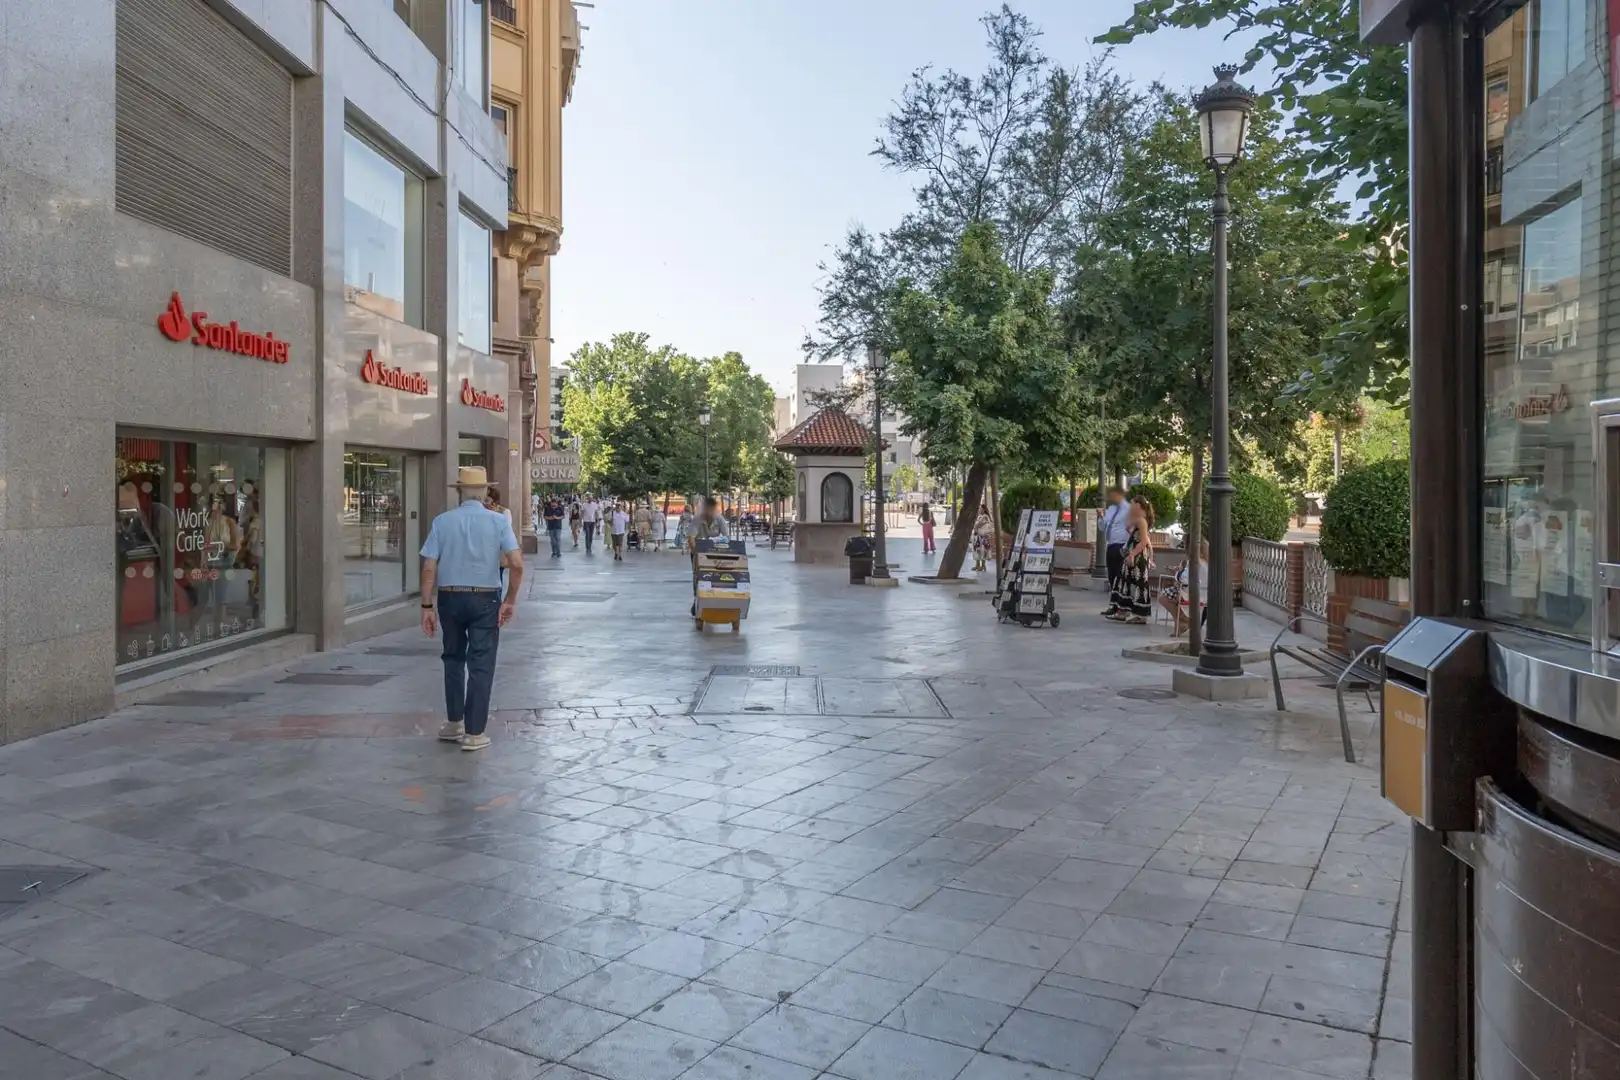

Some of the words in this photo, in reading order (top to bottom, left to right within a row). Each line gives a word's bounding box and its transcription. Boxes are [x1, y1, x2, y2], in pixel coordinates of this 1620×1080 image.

[191, 311, 292, 364] Santander
[377, 361, 428, 395] Santander
[531, 468, 576, 479] OSUNA
[175, 507, 209, 529] Work
[176, 530, 205, 552] Café
